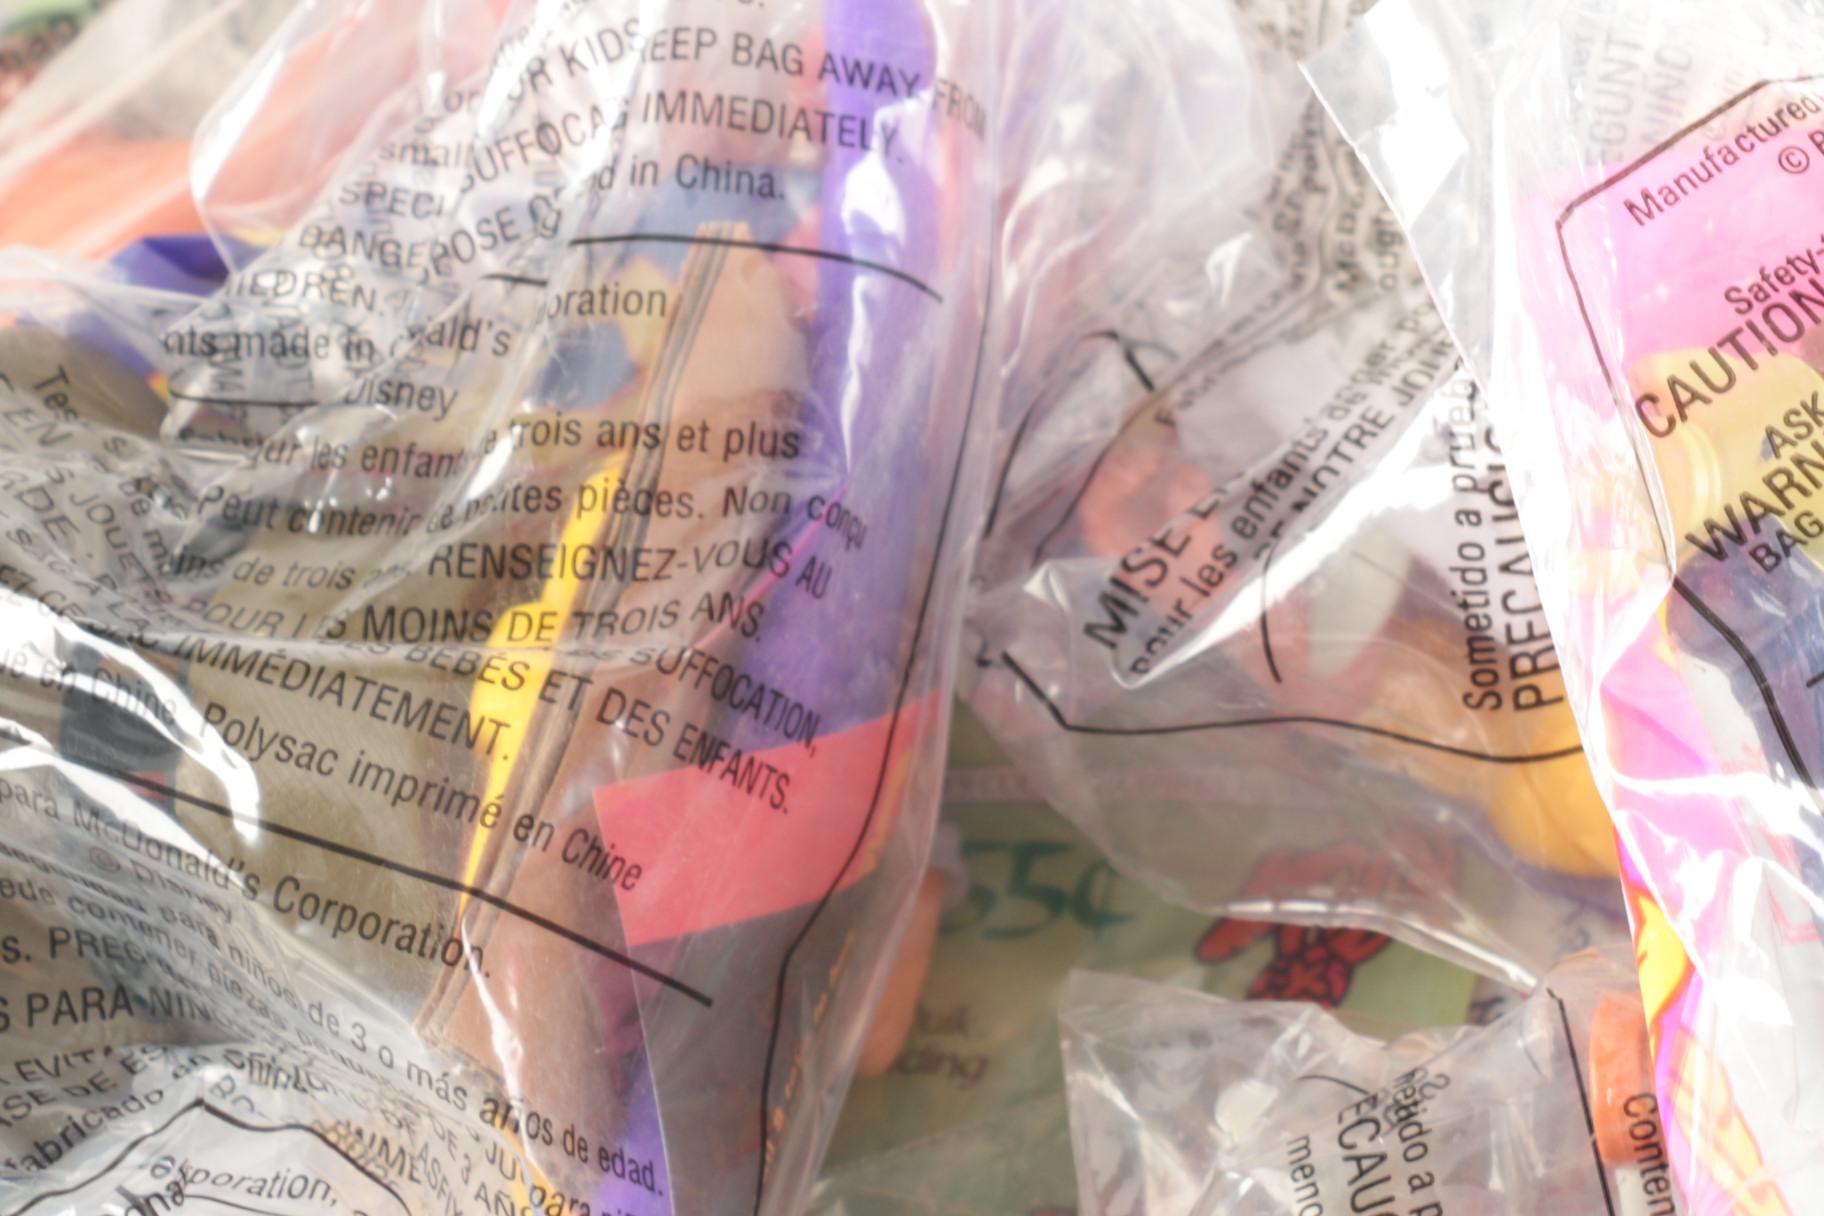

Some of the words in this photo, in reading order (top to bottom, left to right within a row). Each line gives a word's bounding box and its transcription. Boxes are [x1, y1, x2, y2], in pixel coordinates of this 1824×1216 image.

[731, 34, 803, 77] BAG
[817, 51, 921, 99] AWAY
[642, 89, 904, 164] IMMEDIATELY.
[1623, 97, 1822, 227] Manufactured
[675, 154, 786, 201] China.
[595, 417, 661, 450] ans
[677, 423, 711, 452] et
[723, 421, 801, 462] plus
[576, 478, 705, 519] pièces.
[722, 486, 791, 518] Non
[806, 495, 868, 551] conçu
[1454, 506, 1482, 526] a
[427, 539, 793, 583] RENSEIGNEZ-VOUS
[795, 556, 832, 598] AU
[1082, 525, 1191, 650] MISE
[1181, 543, 1239, 600] les
[361, 605, 493, 642] MOINS
[506, 609, 558, 643] DE
[572, 600, 681, 641] TROIS
[689, 591, 765, 645] ANS.
[1448, 539, 1503, 712] Sometido
[177, 633, 511, 762] IMMÉDIATEMENT.
[628, 645, 822, 758] SUFFOCATION,
[539, 670, 593, 712] ET
[595, 687, 672, 748] DES
[673, 723, 791, 815] ENFANTS.
[199, 701, 338, 778] Polysac
[347, 748, 502, 830] imprimé
[512, 812, 555, 853] en
[561, 826, 643, 892] Chine
[271, 875, 491, 979] Corporation.
[26, 985, 136, 1030] PARA
[307, 999, 340, 1034] de
[350, 1022, 368, 1054] 3
[378, 1041, 395, 1067] o
[404, 1061, 469, 1111] más
[562, 1124, 590, 1165] de
[598, 1143, 665, 1196] edad.
